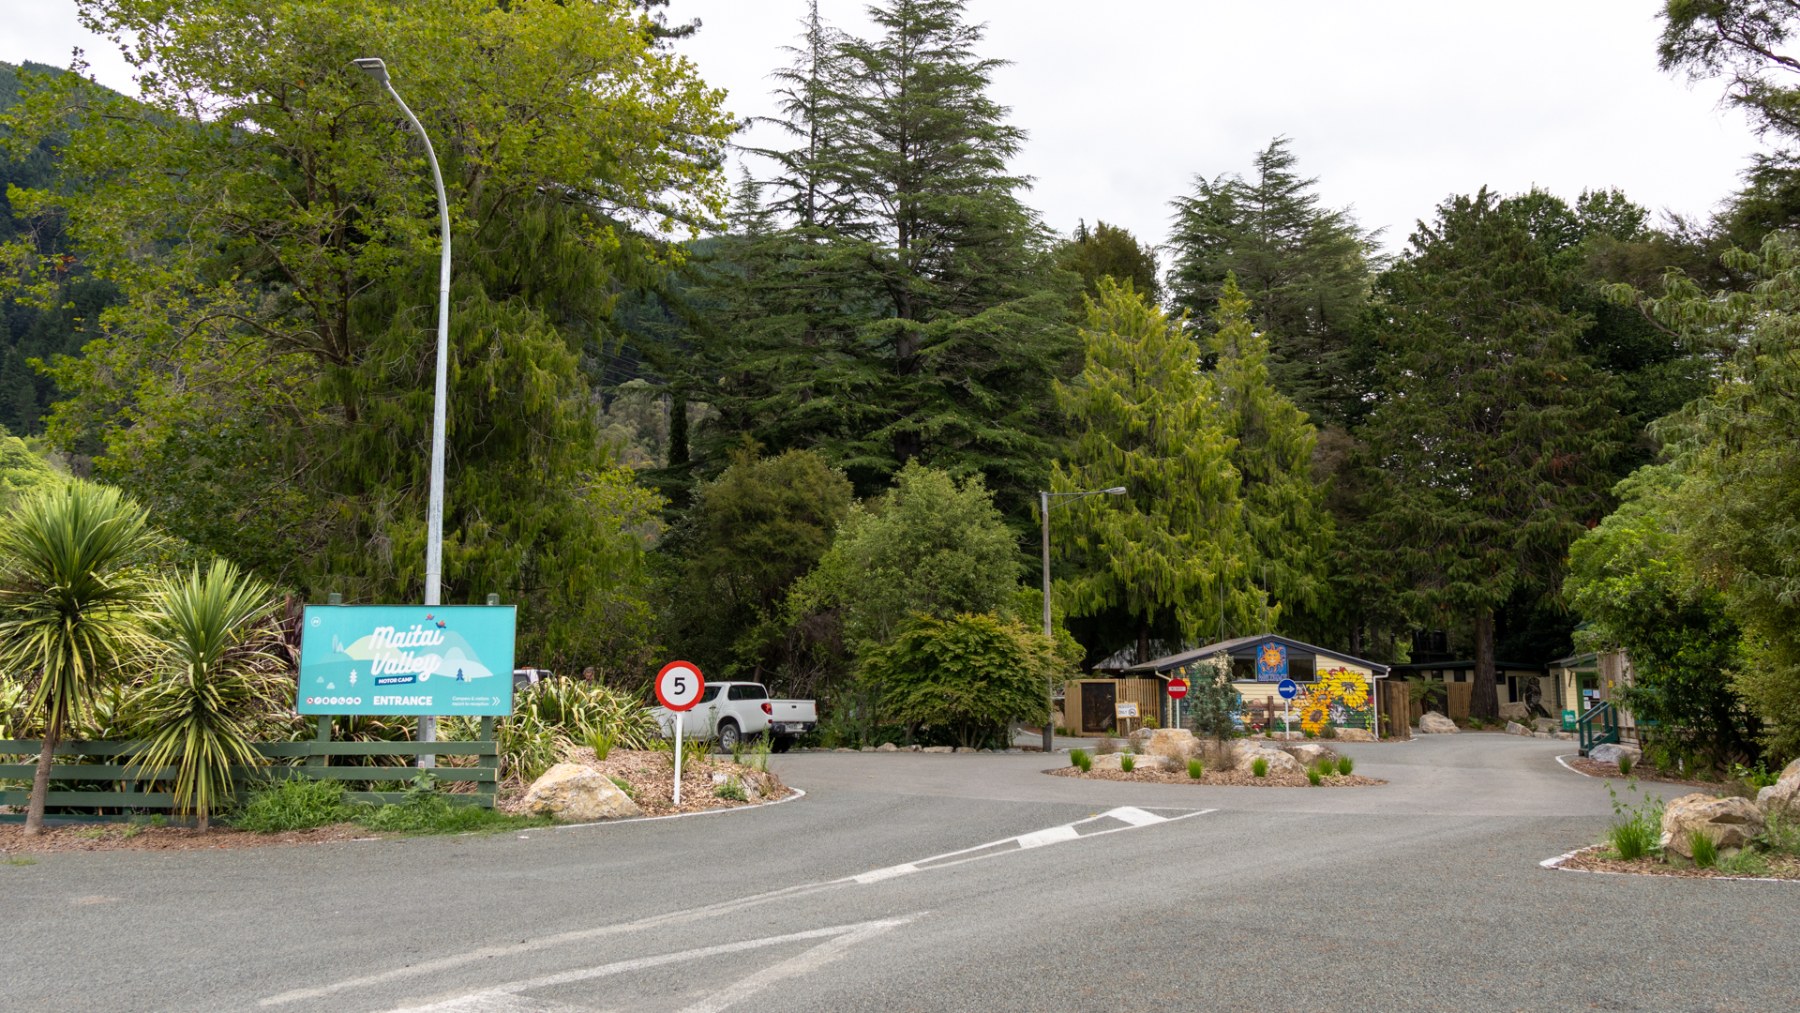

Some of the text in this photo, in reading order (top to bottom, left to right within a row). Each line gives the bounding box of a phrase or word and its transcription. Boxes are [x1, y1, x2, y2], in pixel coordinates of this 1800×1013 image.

[368, 624, 444, 650] Maitai
[370, 651, 441, 681] Valley
[674, 677, 686, 695] 5
[373, 696, 433, 706] ENTRANCE
